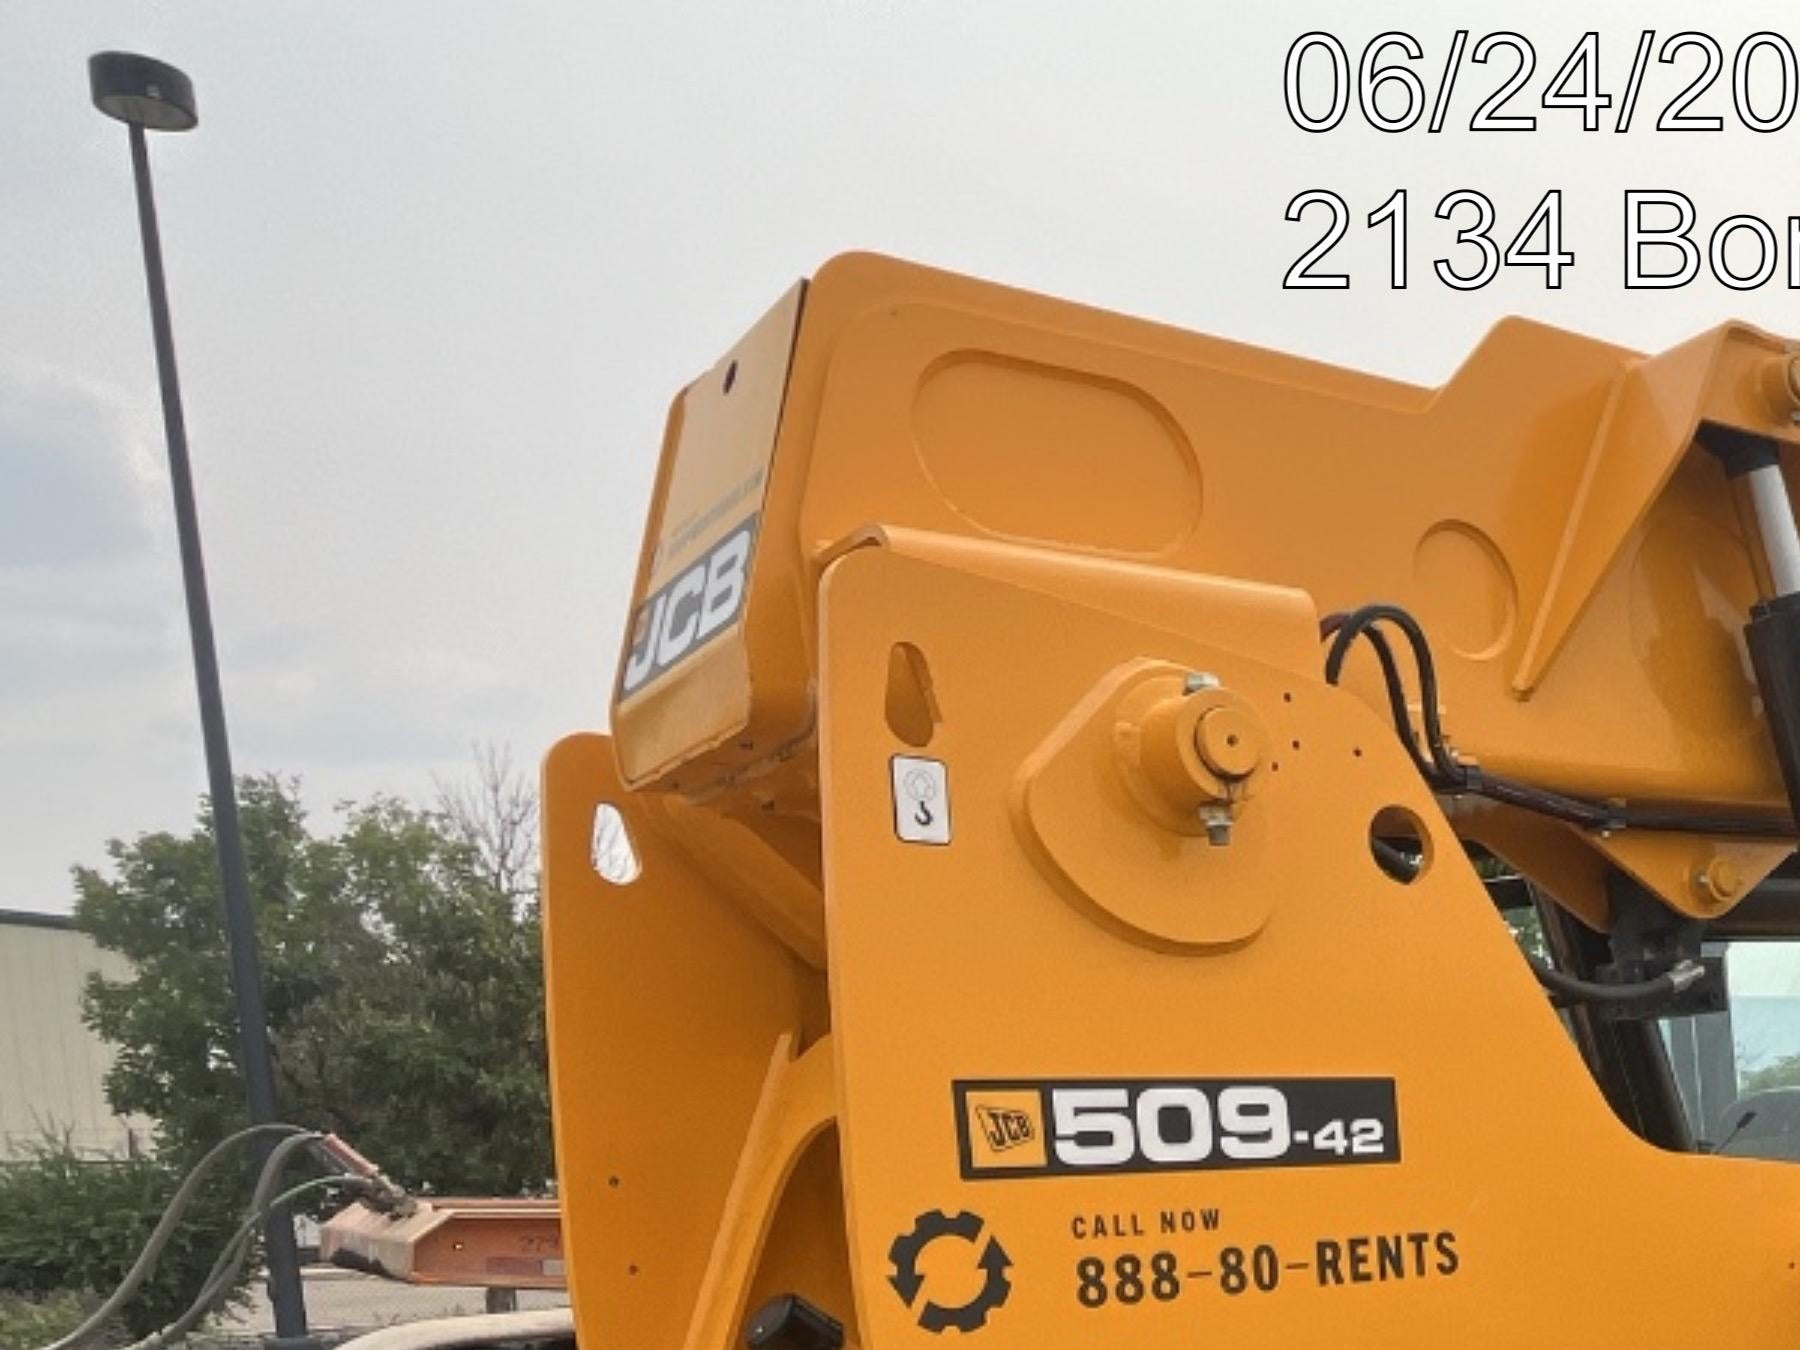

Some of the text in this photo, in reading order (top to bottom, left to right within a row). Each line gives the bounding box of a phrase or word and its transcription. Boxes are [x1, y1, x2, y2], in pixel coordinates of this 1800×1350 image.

[623, 529, 750, 692] JCB
[980, 1107, 1034, 1150] JCB
[1051, 1085, 1385, 1166] 509-42
[1071, 1208, 1221, 1240] CALL NOW
[1075, 1230, 1459, 1309] 888-80-RENTS
